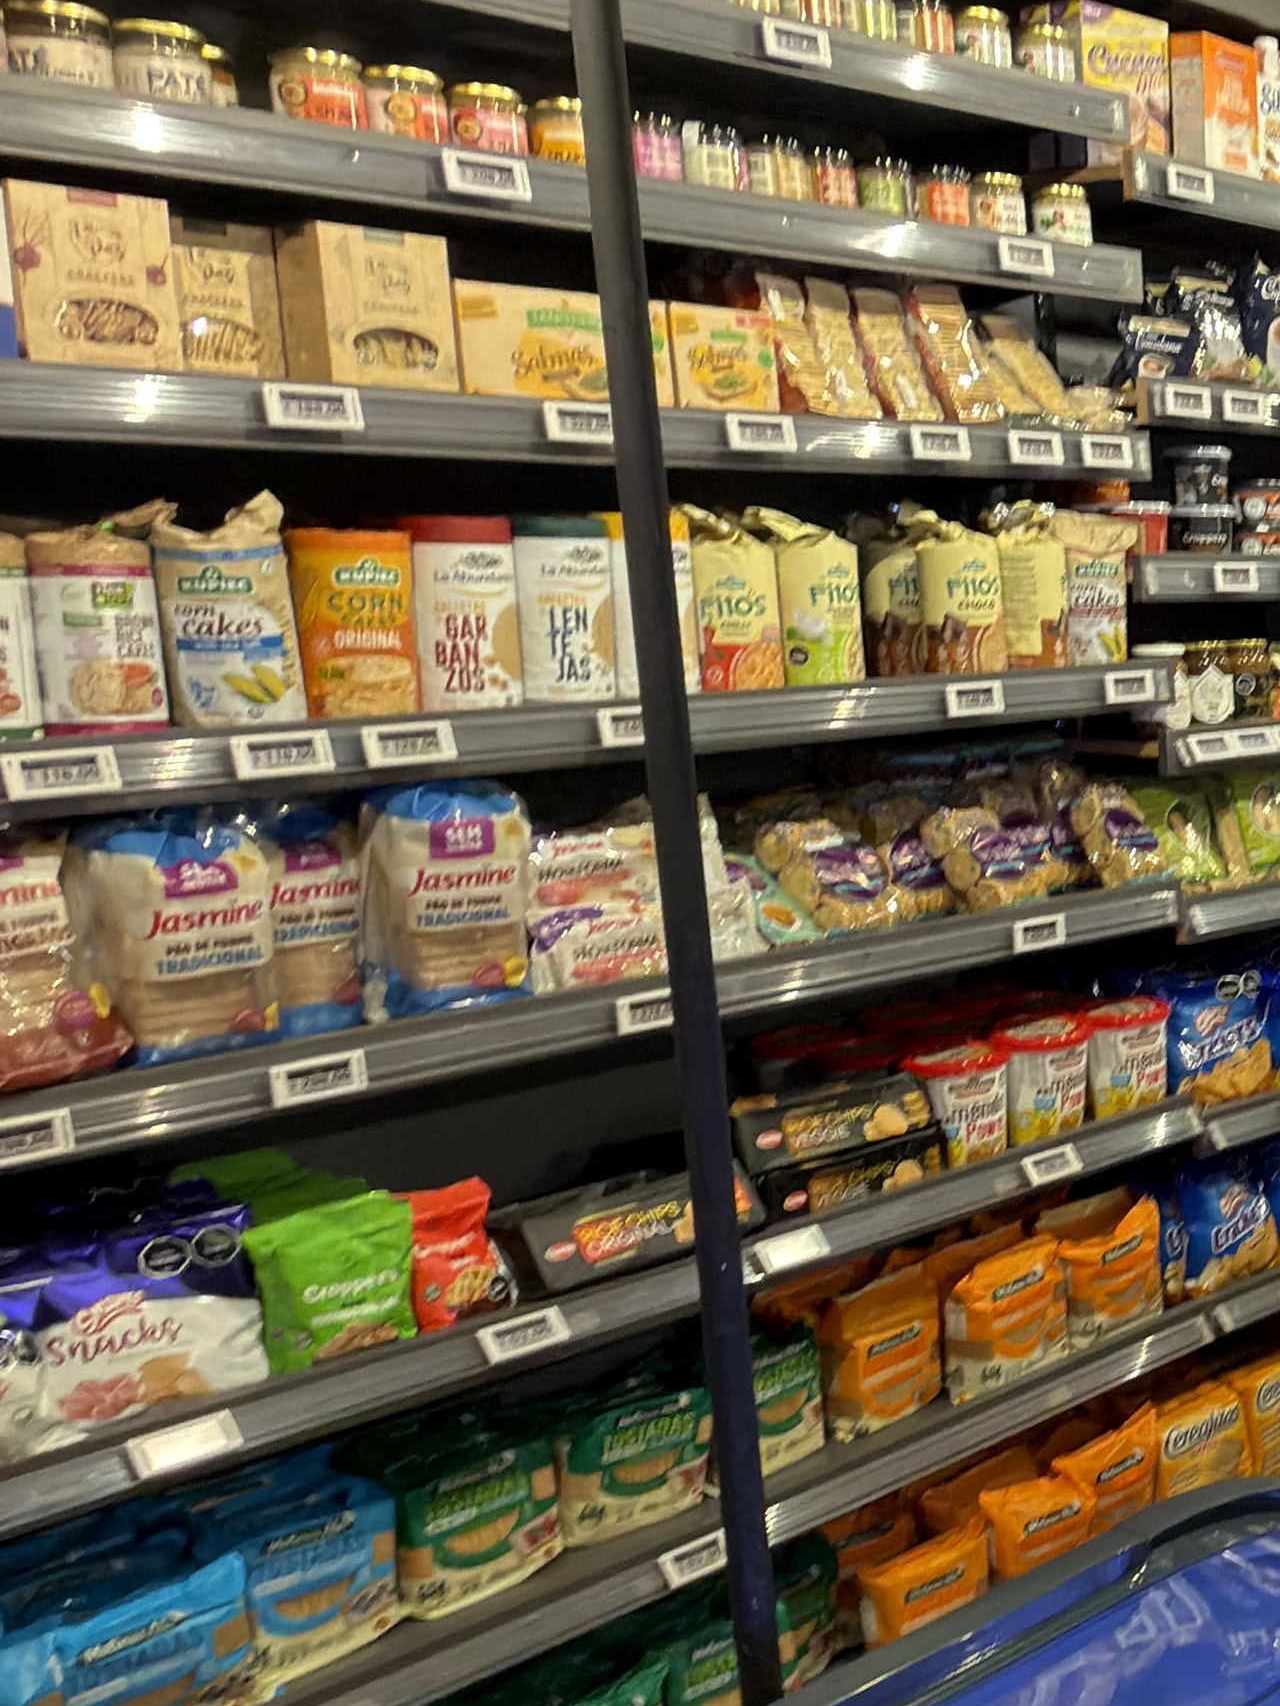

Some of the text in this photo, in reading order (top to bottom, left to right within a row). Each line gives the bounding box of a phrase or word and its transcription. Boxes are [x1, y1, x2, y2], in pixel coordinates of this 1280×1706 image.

[512, 343, 594, 377] Salmas
[327, 594, 404, 614] CORN
[181, 616, 263, 639] cakes
[446, 614, 488, 639] GAR
[551, 607, 588, 635] LEN
[435, 641, 479, 665] BAN
[557, 657, 591, 683] JAS
[411, 861, 516, 897] Jasmine
[144, 898, 264, 940] Jasmine
[273, 918, 360, 945] TRADICIONA
[46, 1316, 183, 1364] Snacks
